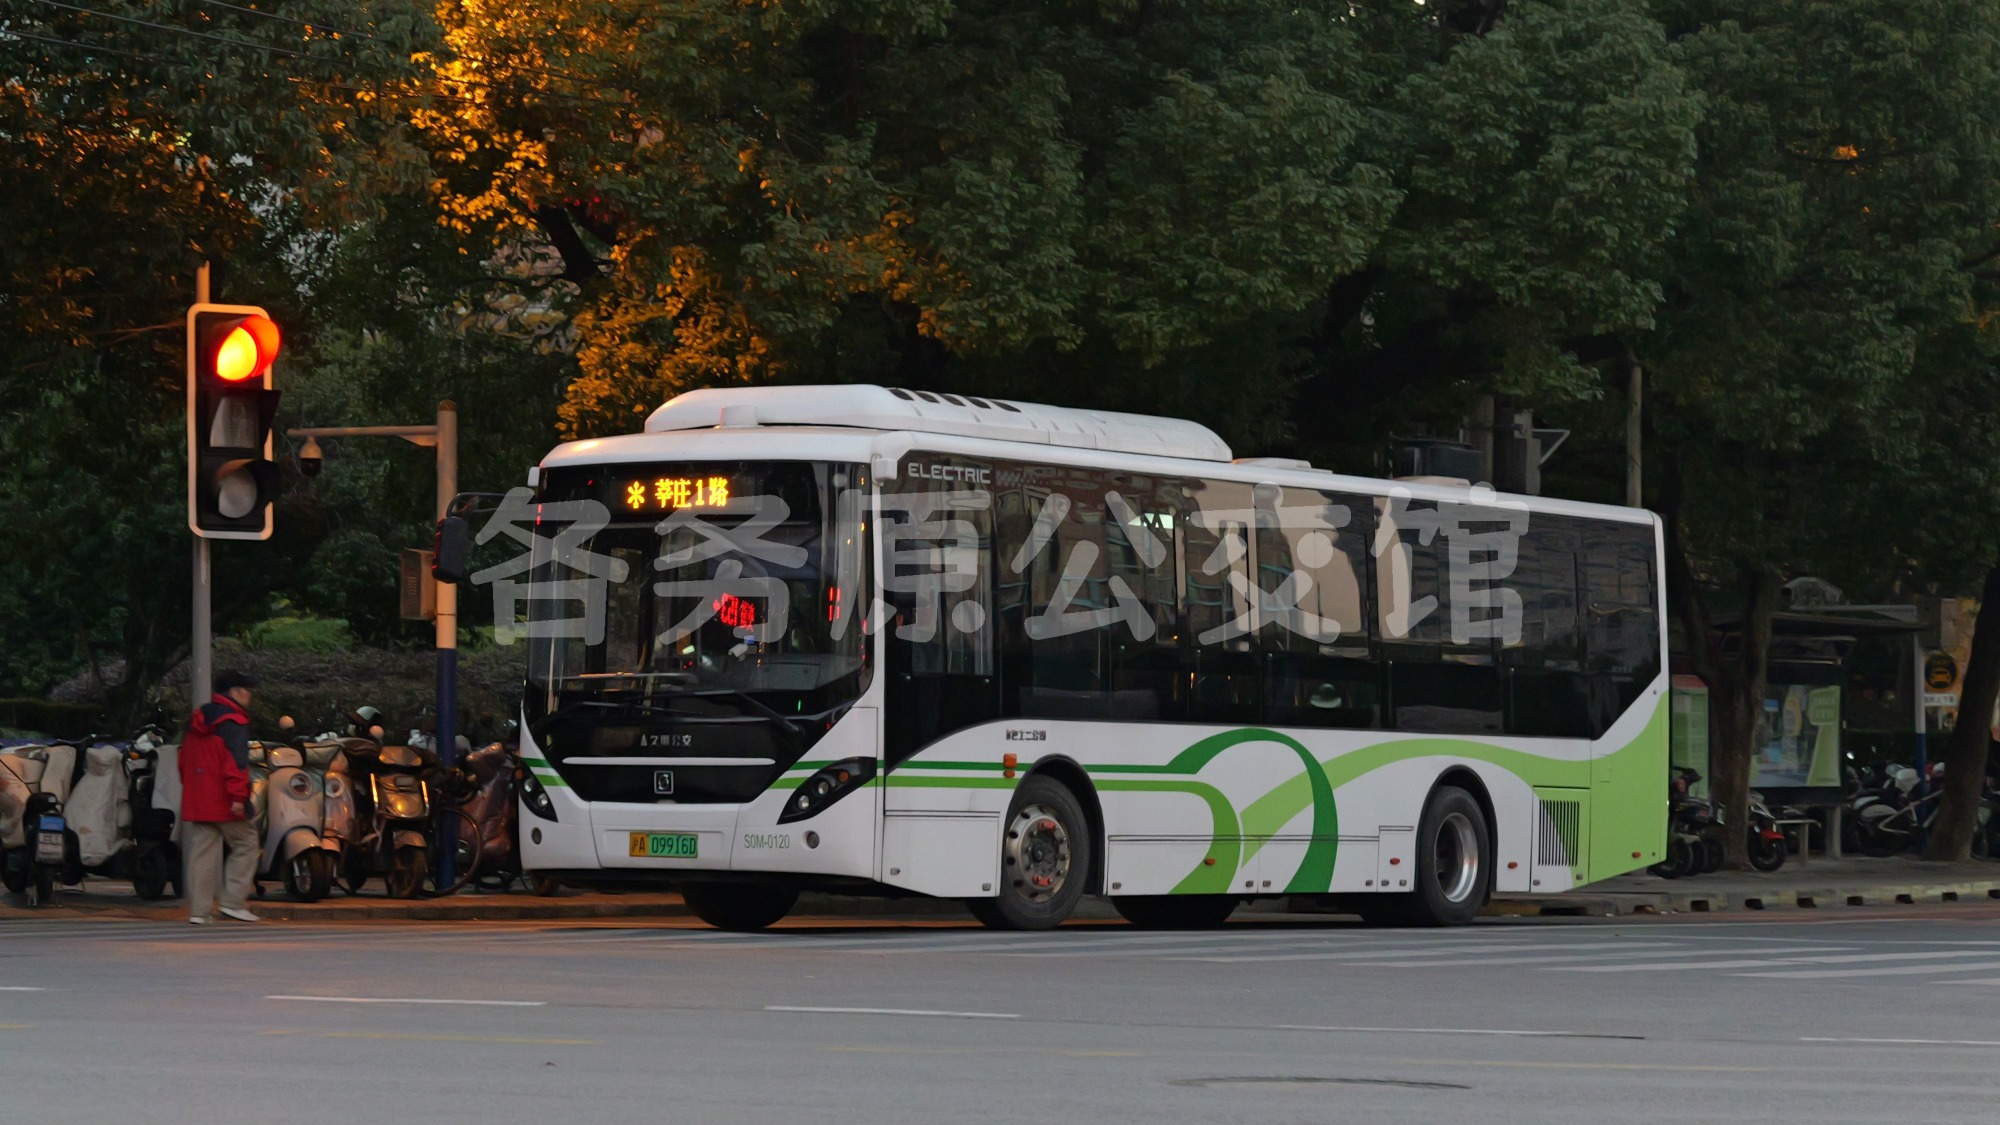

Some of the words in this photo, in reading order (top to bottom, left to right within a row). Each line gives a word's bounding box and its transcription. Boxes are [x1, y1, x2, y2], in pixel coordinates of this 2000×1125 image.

[908, 462, 991, 484] ELECTRIC
[655, 477, 729, 508] 莘庄1路
